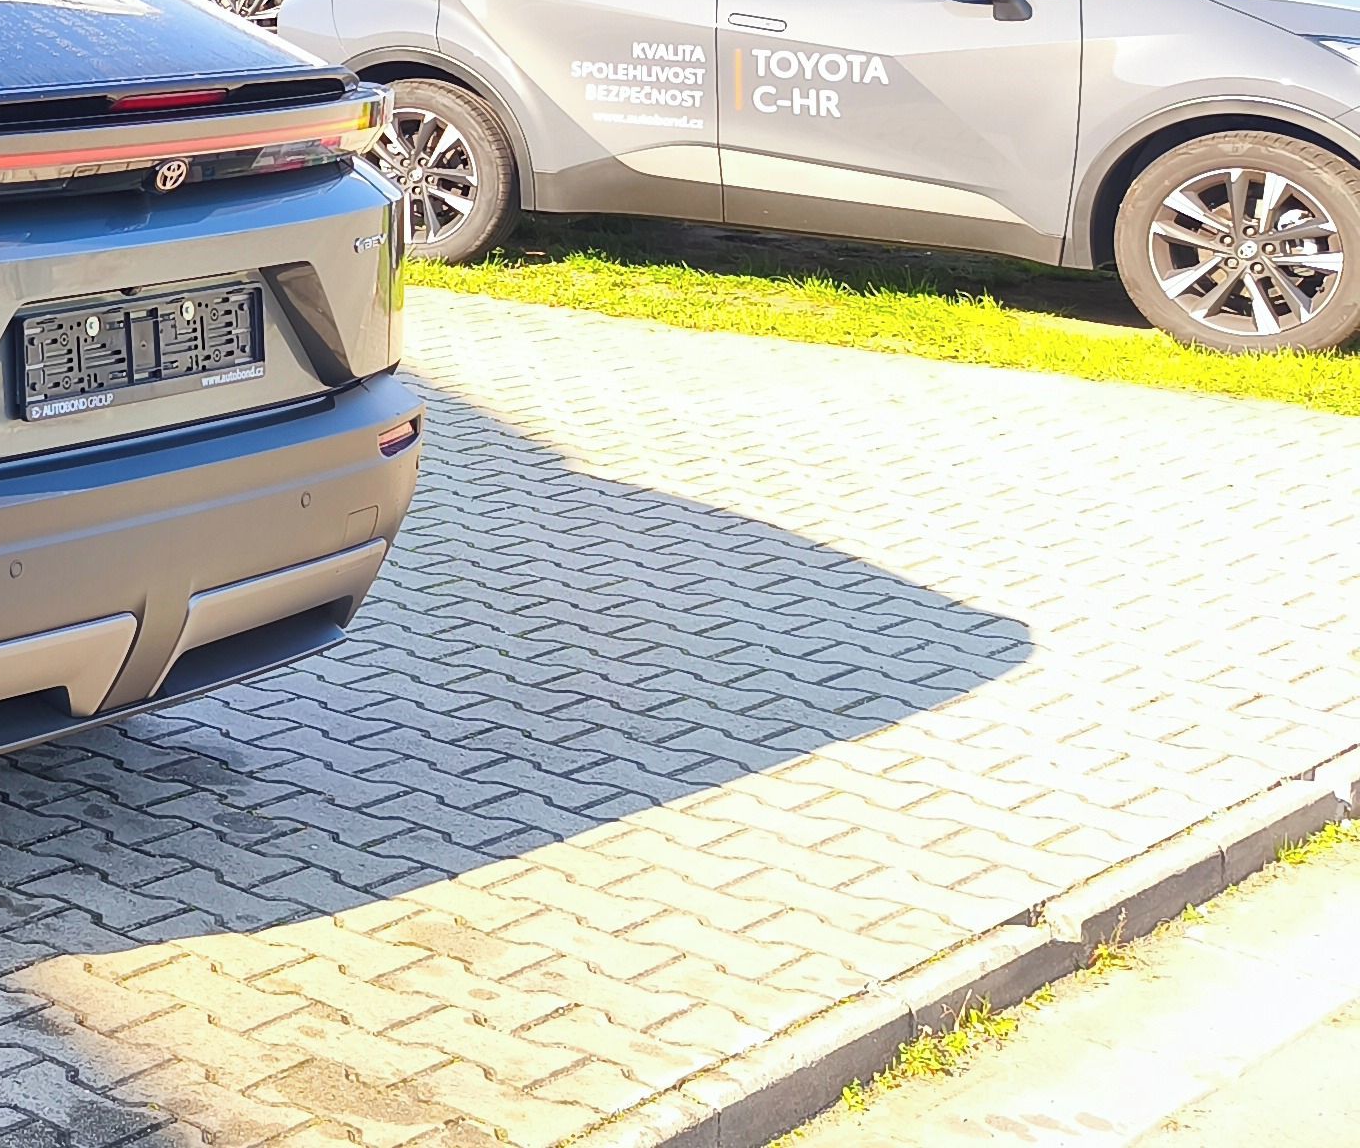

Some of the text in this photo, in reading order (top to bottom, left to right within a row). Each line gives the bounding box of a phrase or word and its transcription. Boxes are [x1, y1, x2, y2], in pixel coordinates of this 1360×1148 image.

[632, 42, 705, 62] KVALITA
[570, 60, 705, 84] SPOLEHLIVOST
[752, 49, 889, 85] TOYOTA
[585, 83, 703, 107] BEZPEČNOST
[752, 86, 841, 118] C-HR
[592, 112, 703, 129] www.autobond.cz
[201, 366, 264, 387] www.autobond.cz
[43, 393, 114, 416] AUTOBOND GROUP
